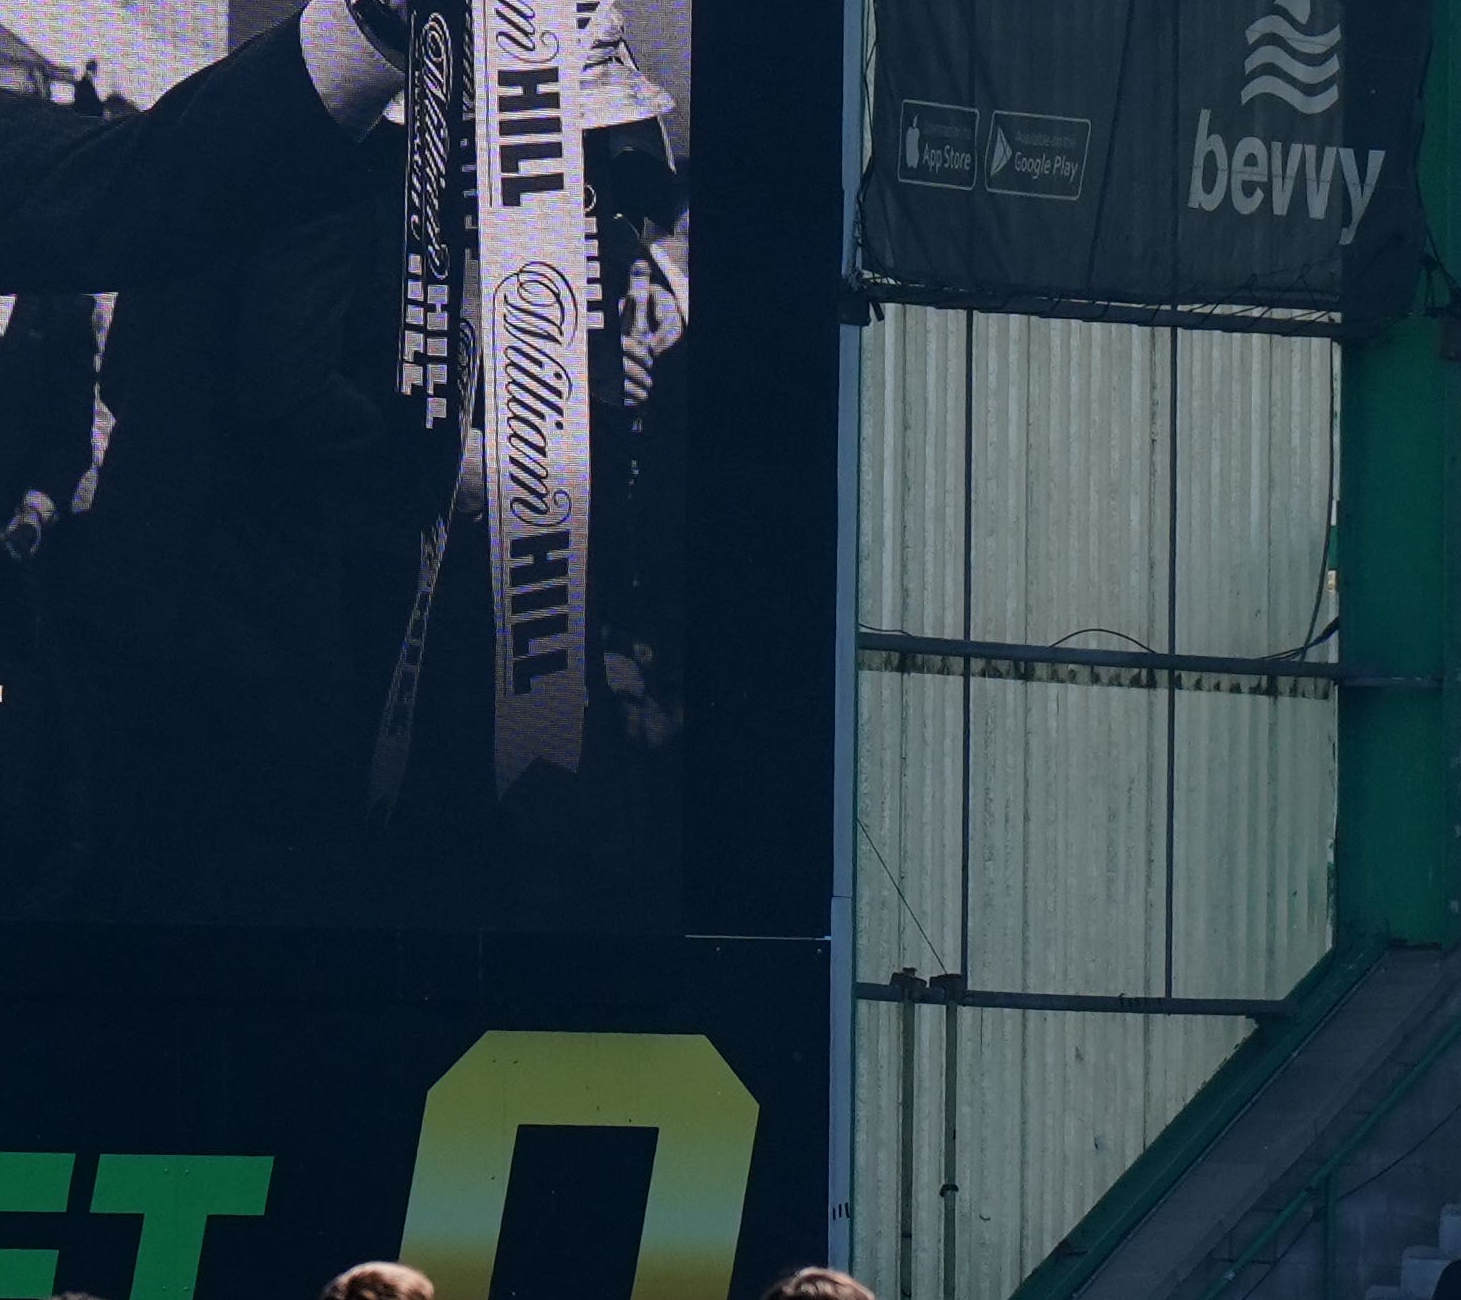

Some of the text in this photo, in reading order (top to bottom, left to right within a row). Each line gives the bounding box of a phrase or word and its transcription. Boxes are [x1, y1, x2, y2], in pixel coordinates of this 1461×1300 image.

[495, 67, 566, 208] HILL
[1014, 151, 1079, 183] Google Play
[1187, 107, 1387, 247] bevvy
[425, 283, 450, 429] HILL
[493, 260, 580, 696] William HILL
